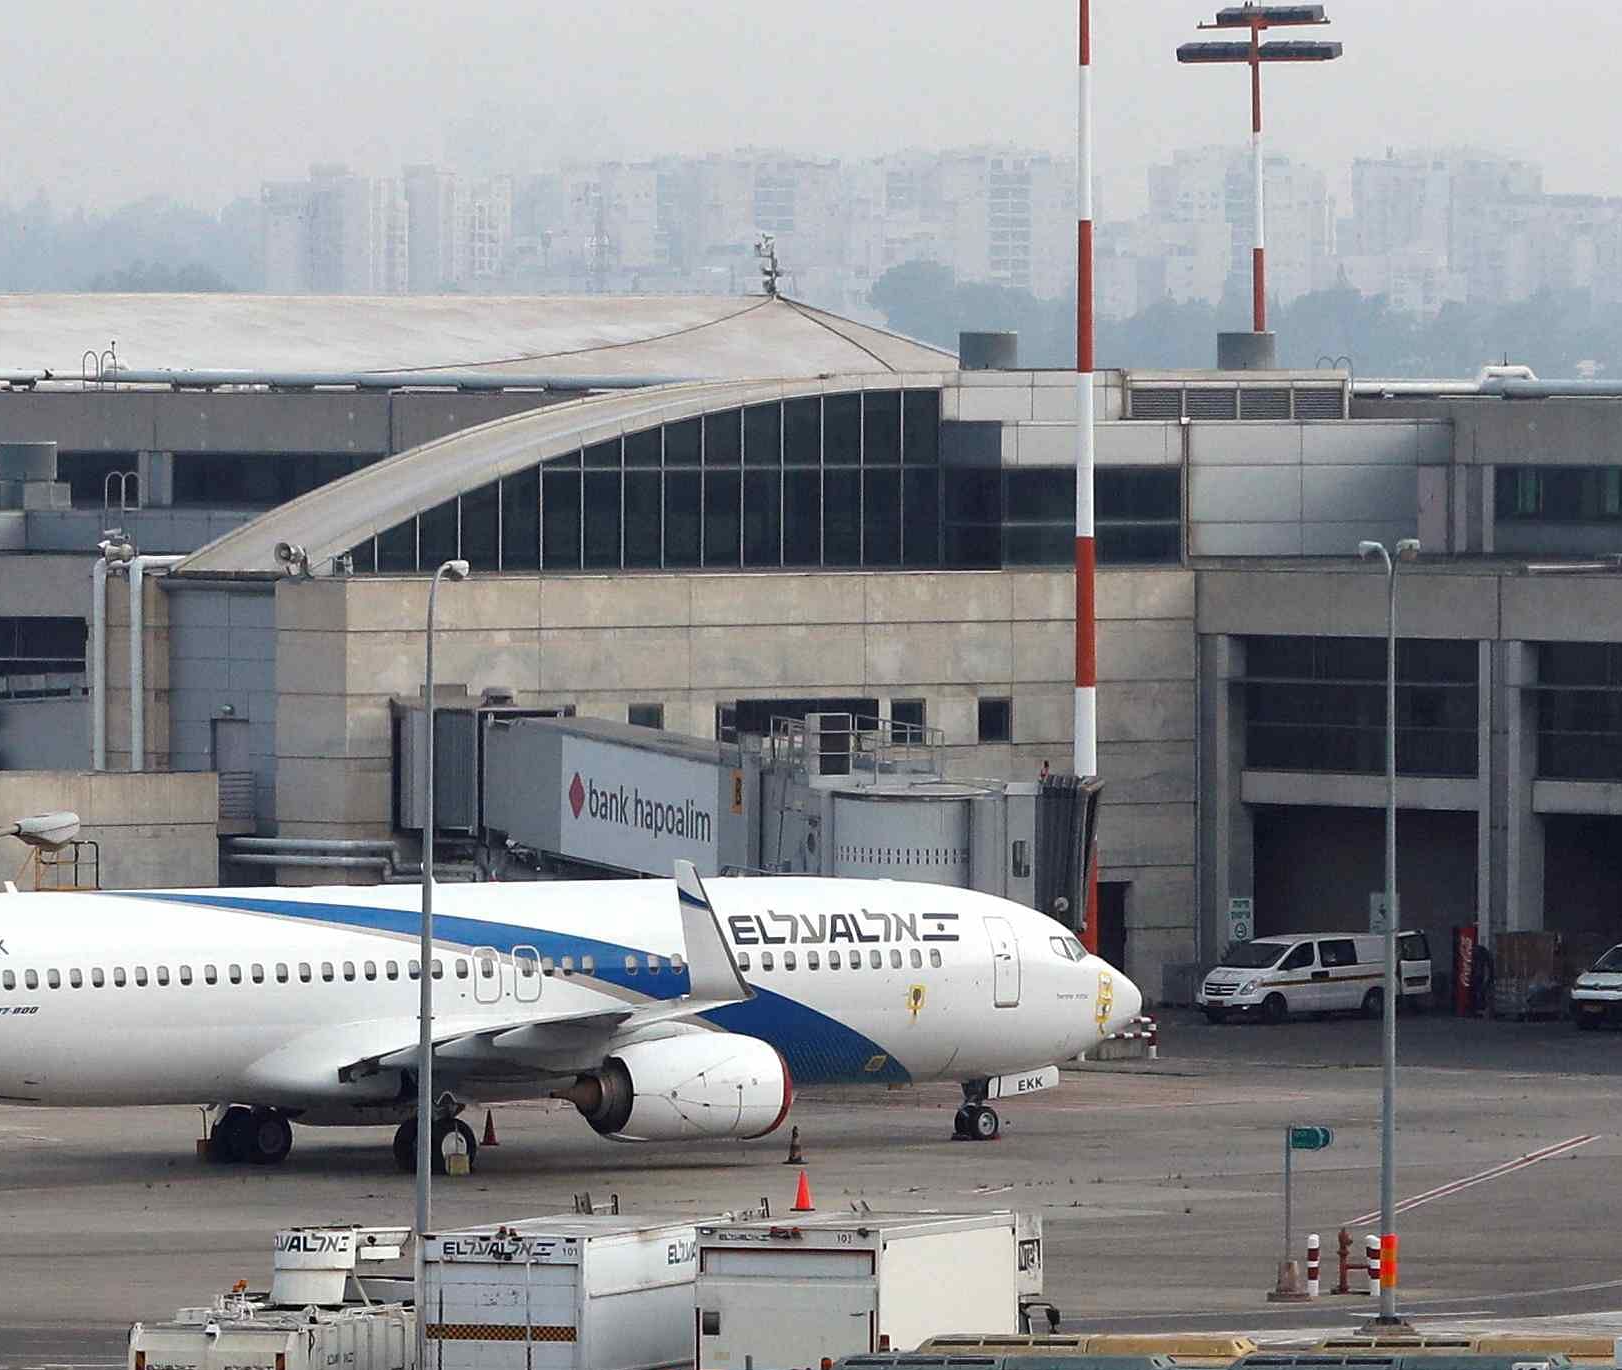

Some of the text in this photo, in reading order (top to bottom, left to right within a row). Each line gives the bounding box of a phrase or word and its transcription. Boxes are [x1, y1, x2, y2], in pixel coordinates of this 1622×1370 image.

[588, 778, 711, 842] bank hapoalim
[1018, 1076, 1044, 1092] EKK
